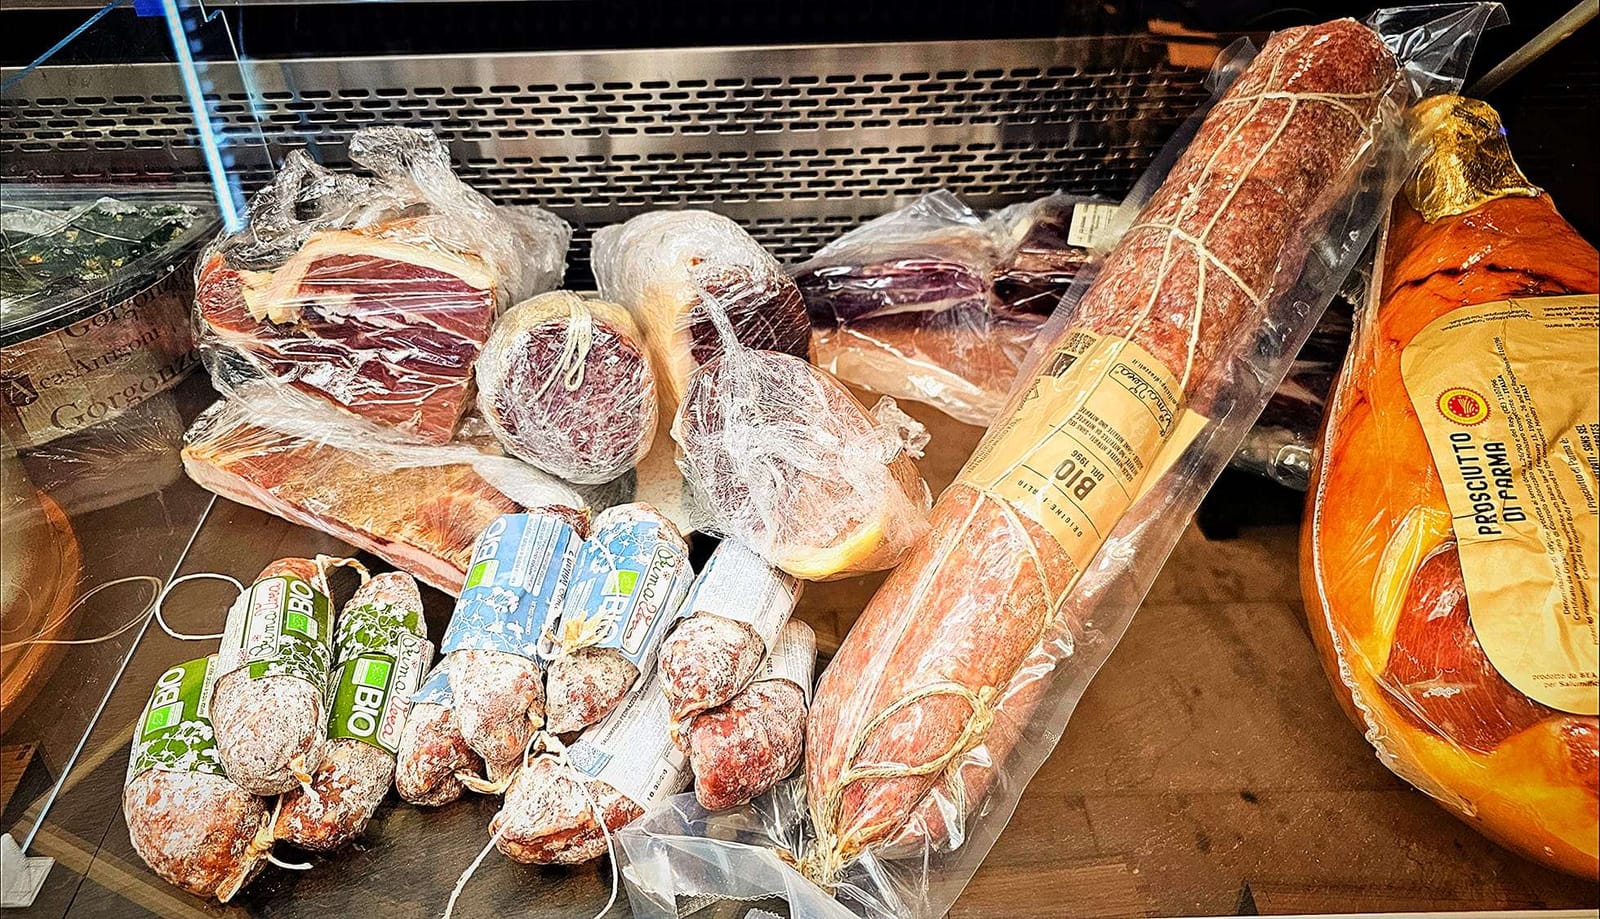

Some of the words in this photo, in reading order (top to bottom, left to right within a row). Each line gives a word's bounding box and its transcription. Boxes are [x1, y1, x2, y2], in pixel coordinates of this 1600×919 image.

[51, 352, 201, 431] Gorgonzo
[1497, 374, 1509, 394] ITALIA
[1513, 385, 1521, 394] EC
[1519, 384, 1531, 401] ITALY
[1516, 394, 1524, 403] and
[1525, 418, 1535, 432] 1990
[1575, 424, 1588, 434] SEL
[1520, 433, 1532, 459] Ministero
[1563, 445, 1578, 466] Parma
[1580, 435, 1593, 451] SANS
[1071, 450, 1090, 468] 1996
[1483, 442, 1518, 501] PARMA
[1054, 459, 1097, 501] BIO
[1090, 465, 1105, 482] DAL
[1449, 432, 1502, 535] PROSCIUTTO
[1017, 480, 1048, 503] IALIA
[1529, 472, 1545, 502] autorizzato
[1546, 484, 1556, 501] Italian
[1575, 474, 1597, 508] Prosciutto
[1050, 504, 1083, 537] ORIGINE
[1502, 506, 1526, 523] DI
[1542, 504, 1556, 530] Controllo
[480, 517, 507, 561] BIO
[287, 580, 315, 616] BIO
[1569, 585, 1581, 621] Certificato
[152, 667, 186, 706] BIO
[347, 686, 388, 737] BIO
